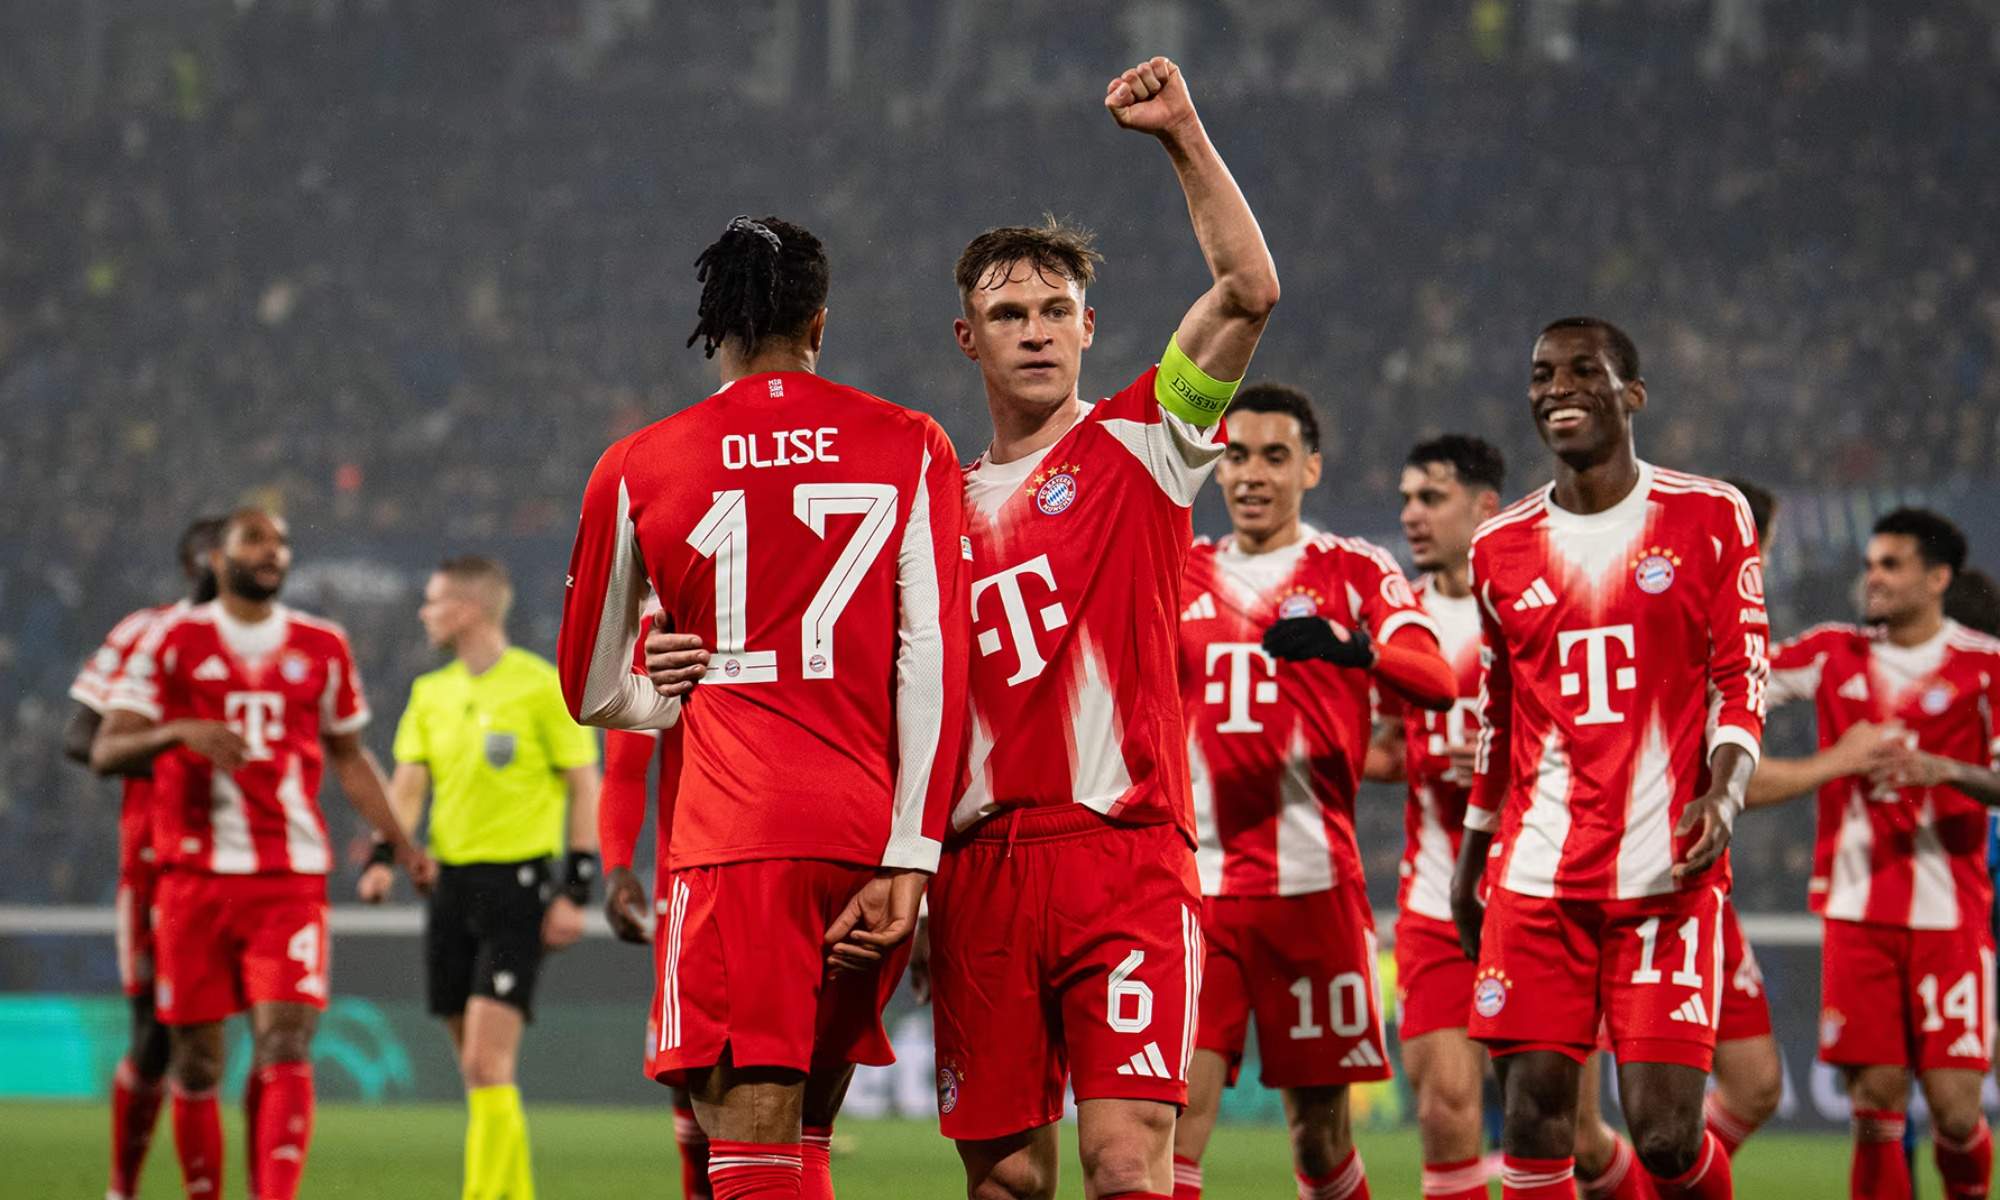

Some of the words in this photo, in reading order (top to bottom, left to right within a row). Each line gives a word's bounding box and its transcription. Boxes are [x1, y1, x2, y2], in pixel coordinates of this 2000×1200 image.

[1171, 377, 1218, 410] RESPECT
[722, 427, 840, 470] OLISE
[685, 482, 899, 685] 17
[970, 553, 1069, 687] T
[1557, 623, 1637, 726] T
[287, 922, 318, 971] 4
[1631, 916, 1703, 989] 11
[1107, 949, 1153, 1033] 6
[1289, 971, 1369, 1040] 10
[1917, 971, 1977, 1032] 14
